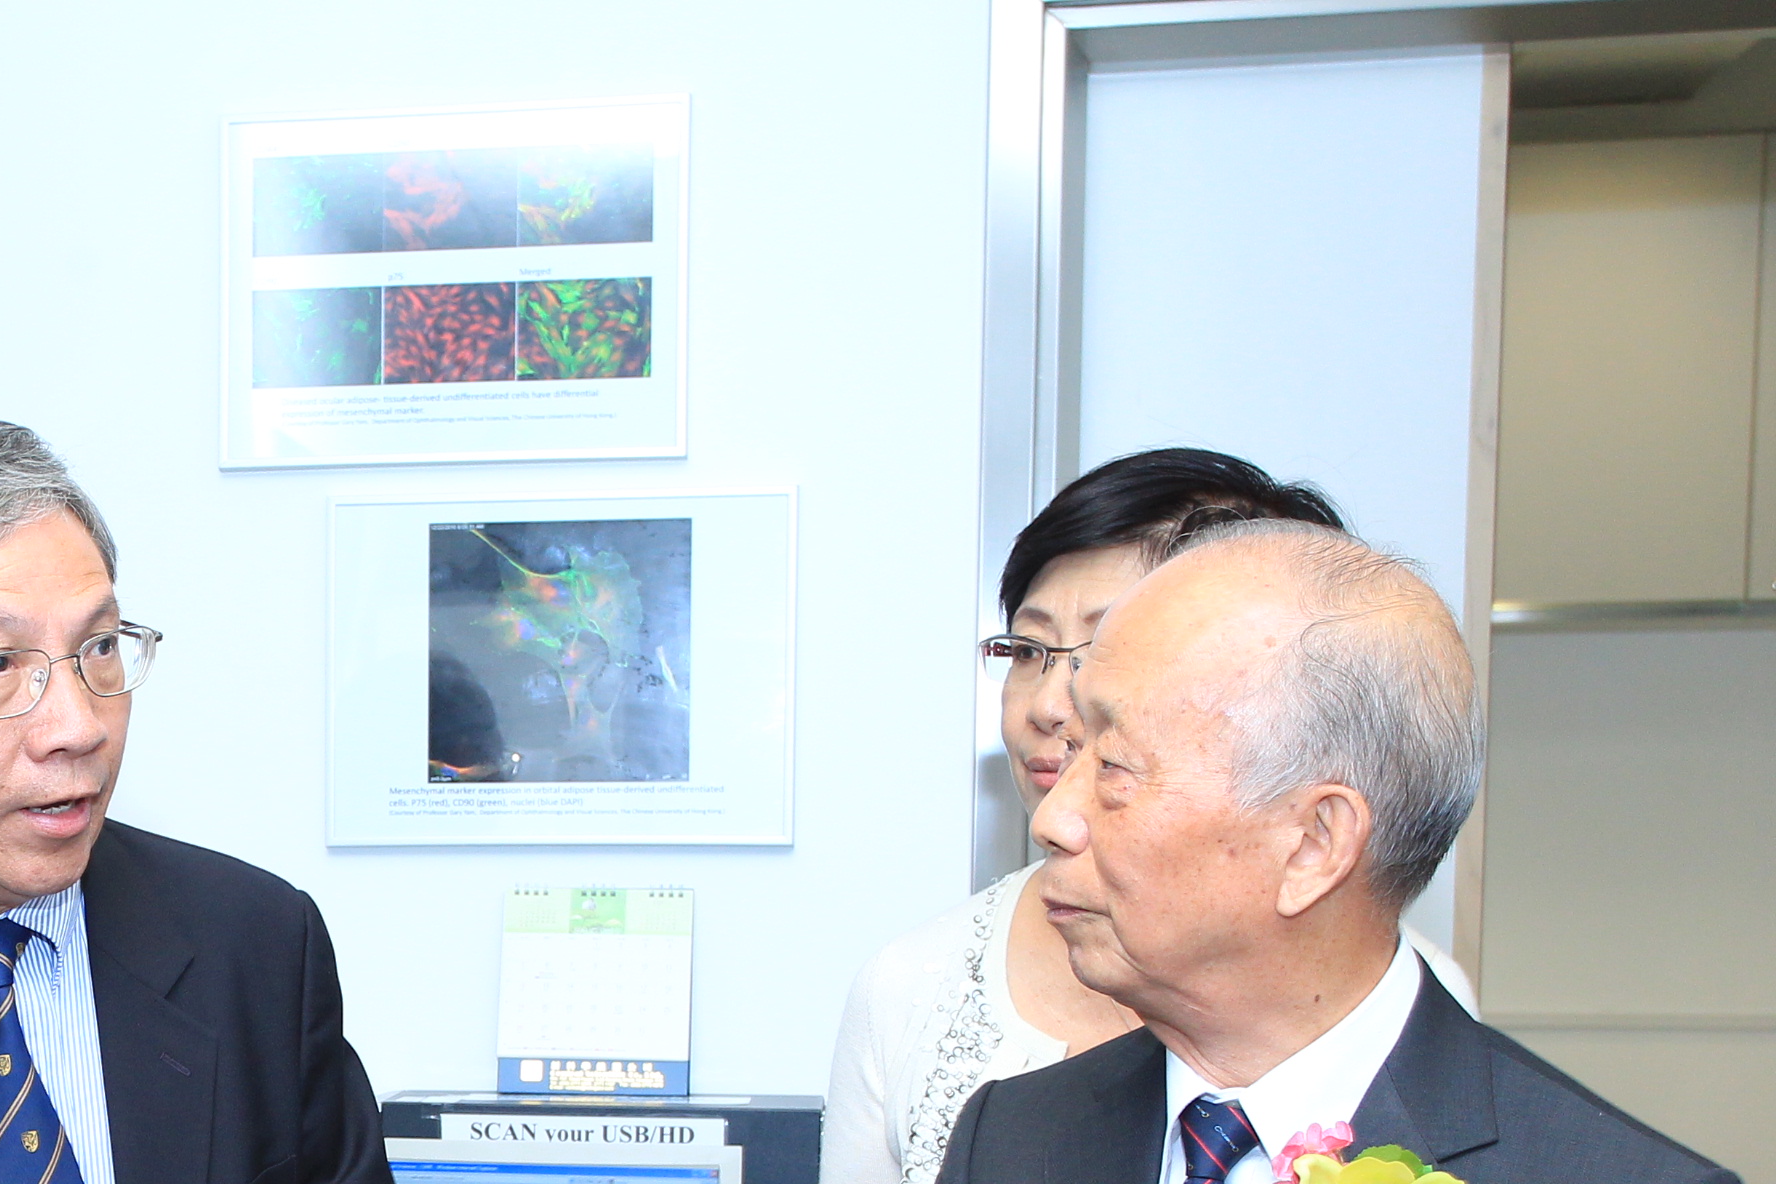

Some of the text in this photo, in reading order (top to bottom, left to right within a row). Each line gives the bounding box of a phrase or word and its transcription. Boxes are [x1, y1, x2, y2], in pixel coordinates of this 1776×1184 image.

[511, 391, 530, 400] cells
[532, 390, 551, 399] have
[389, 787, 445, 796] Mesenchymal
[447, 787, 476, 795] marker
[478, 787, 522, 796] expression
[523, 786, 531, 794] in
[533, 786, 560, 795] orbital
[562, 785, 594, 795] adipose
[657, 785, 725, 794] undifferentiated
[411, 798, 426, 807] P75
[452, 798, 474, 807] CD90
[510, 797, 535, 807] nuclei
[470, 1121, 695, 1145] SCAN your USB/HD
